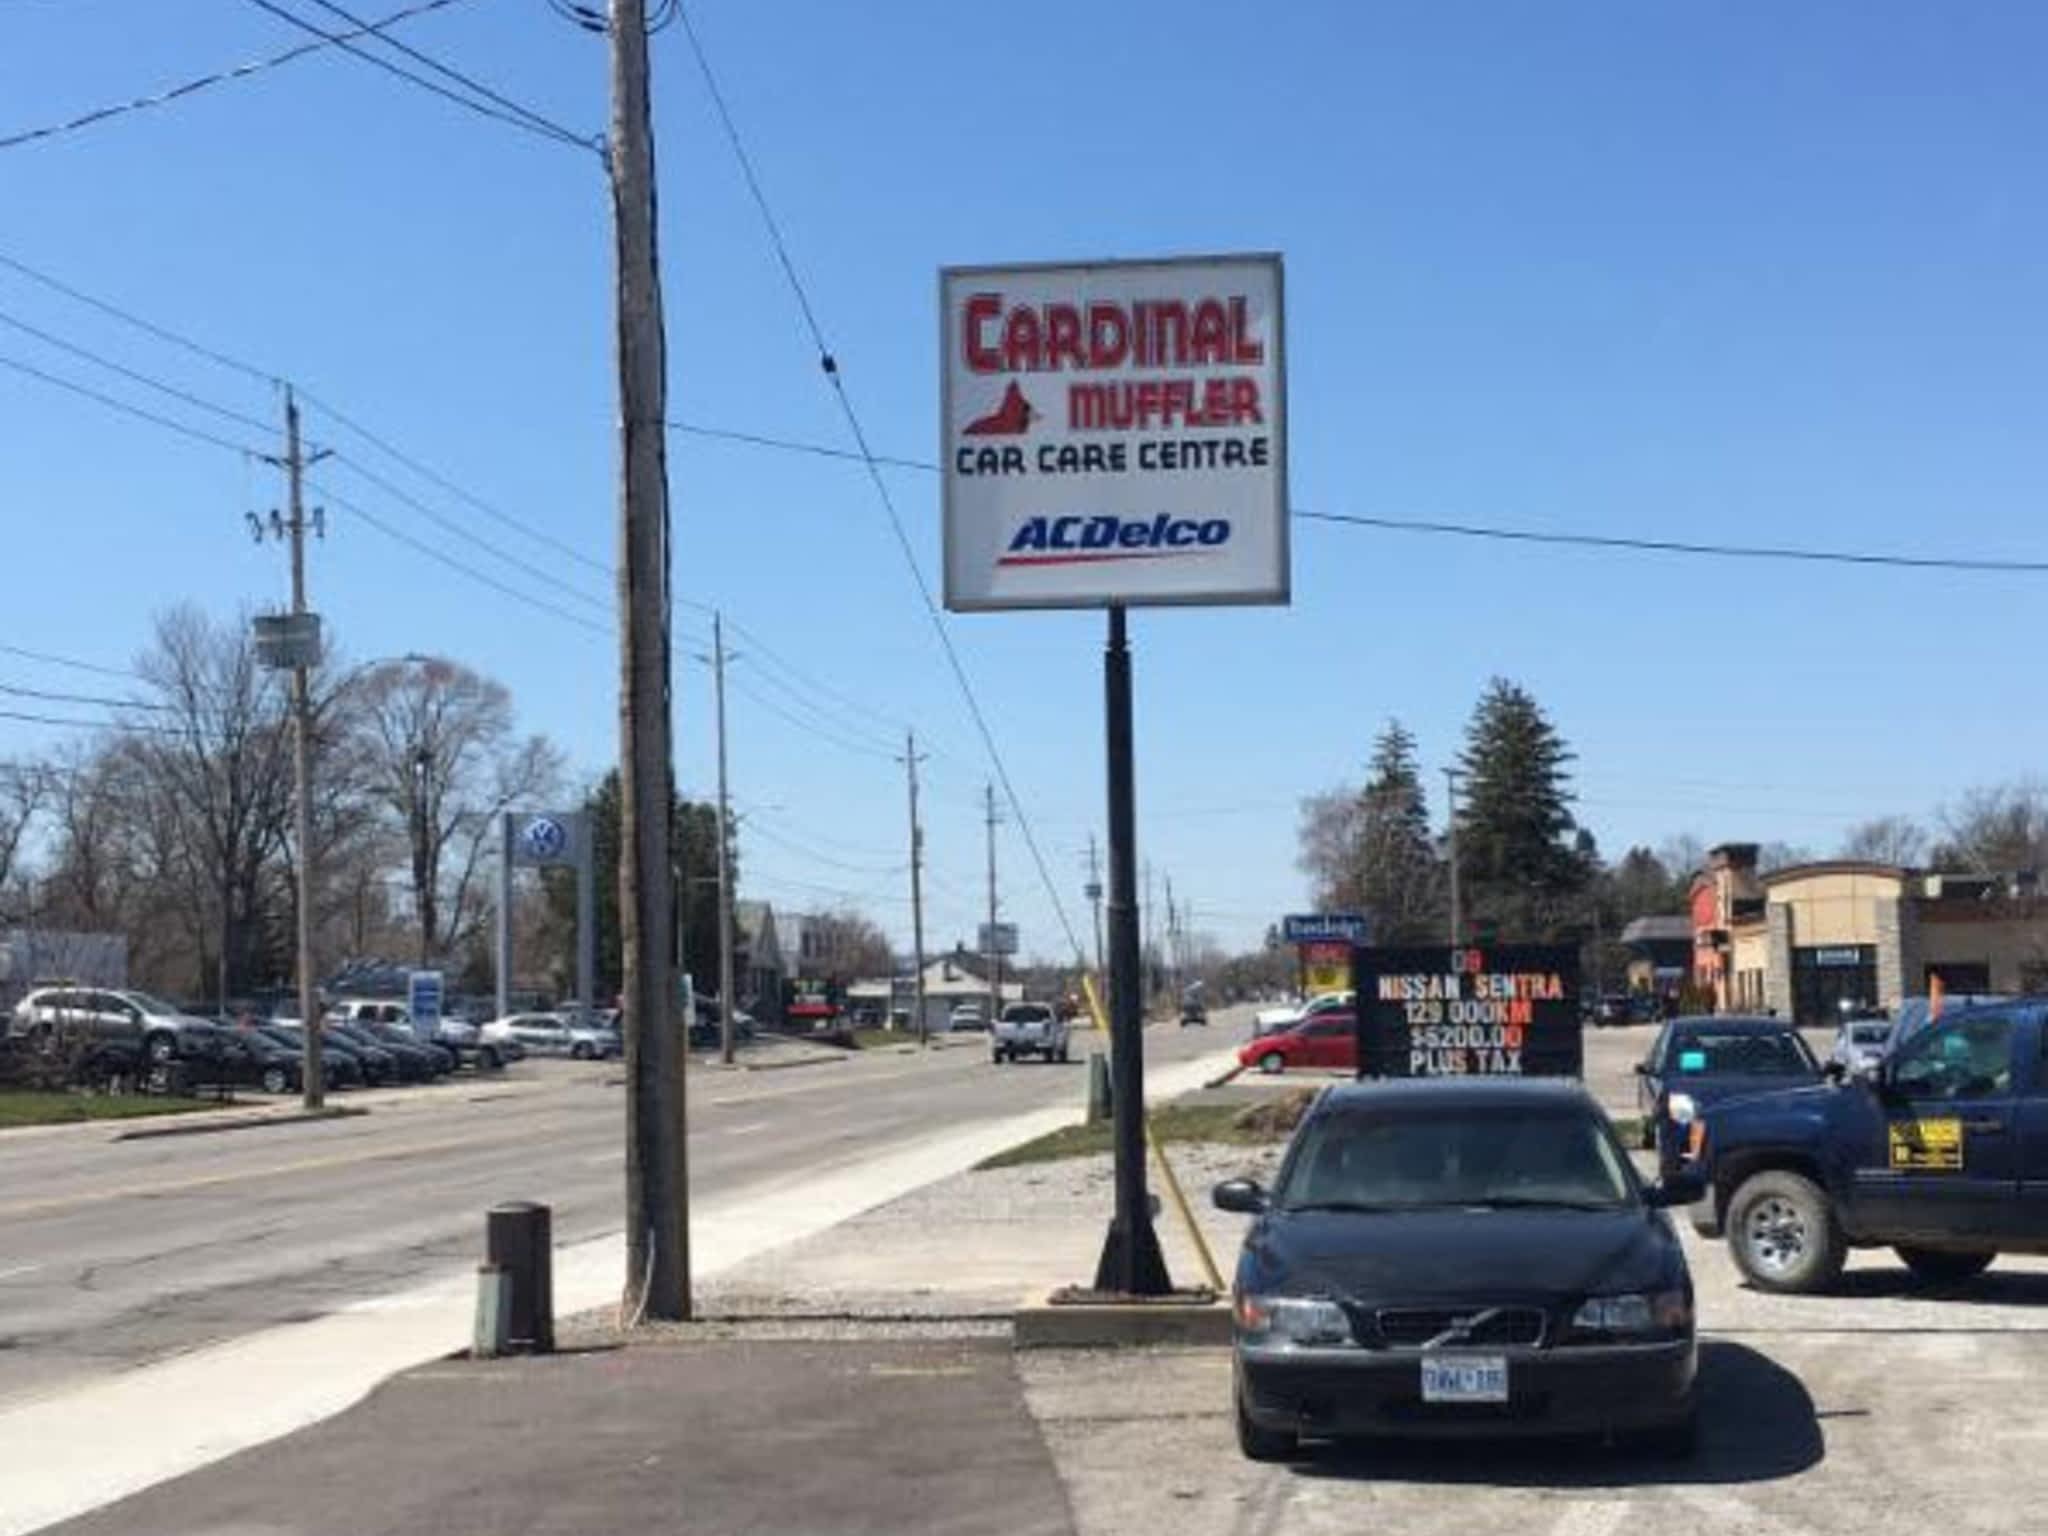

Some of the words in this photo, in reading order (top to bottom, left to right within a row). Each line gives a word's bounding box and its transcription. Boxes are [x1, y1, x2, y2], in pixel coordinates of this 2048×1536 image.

[963, 293, 1263, 374] CARDINAL
[1067, 376, 1264, 429] MUFFLER
[956, 447, 1026, 475] CAR
[1037, 443, 1127, 473] CARE
[1138, 437, 1269, 470] CENTRE
[1007, 513, 1231, 551] ACDelco
[1379, 975, 1461, 1000] NISSAN
[1474, 973, 1563, 999] SENTRA
[1409, 1025, 1522, 1048] $5200.00
[1410, 1050, 1467, 1074] PLUS
[1475, 1049, 1521, 1072] TAX
